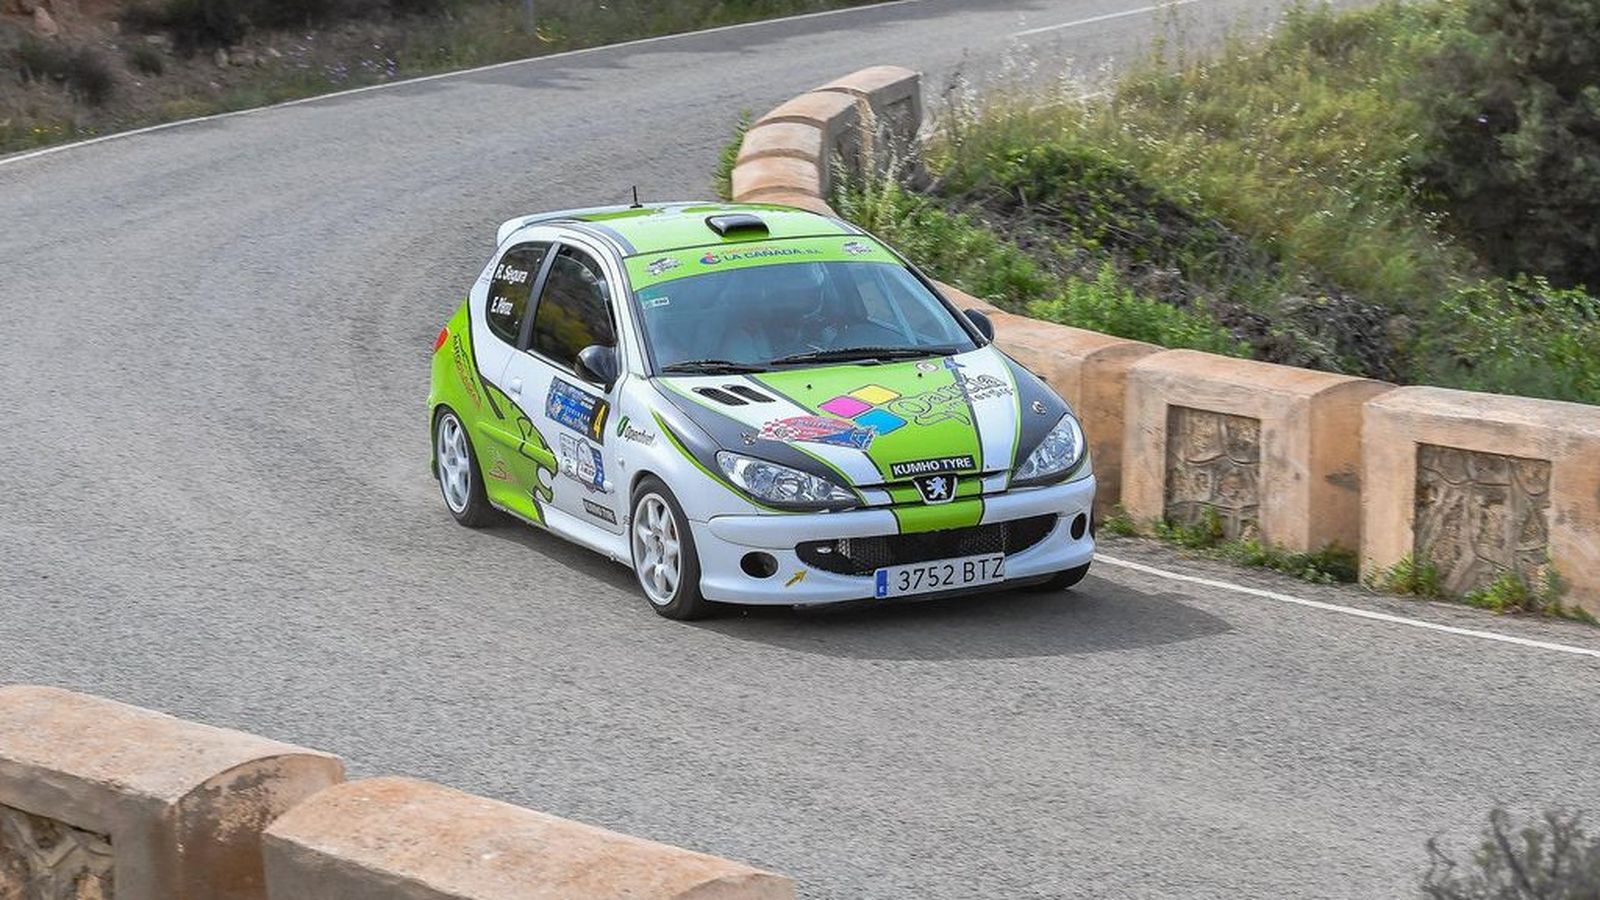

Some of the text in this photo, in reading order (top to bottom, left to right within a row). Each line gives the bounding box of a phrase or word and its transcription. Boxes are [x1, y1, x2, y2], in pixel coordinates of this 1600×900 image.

[592, 404, 606, 439] 4
[893, 457, 972, 476] KUMHO TYRE
[898, 557, 1004, 591] 3752 BTZ
